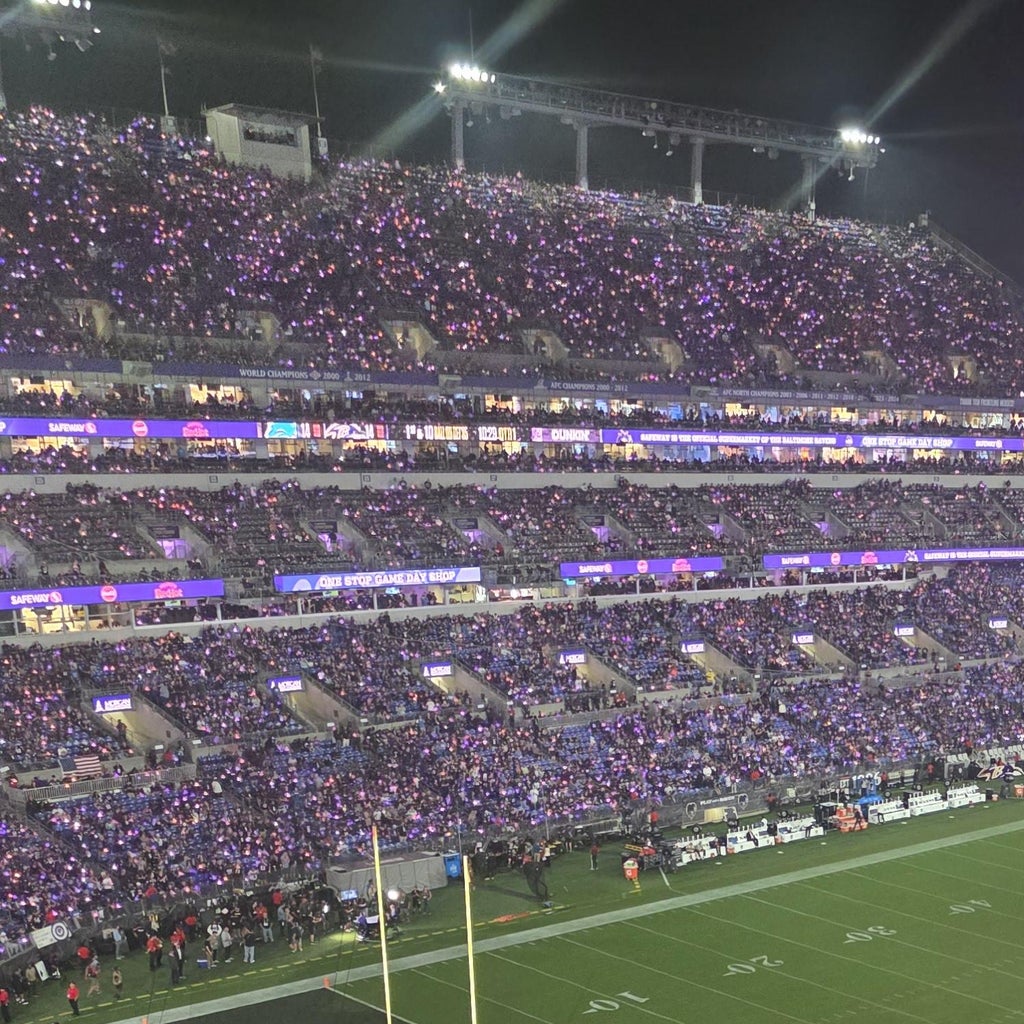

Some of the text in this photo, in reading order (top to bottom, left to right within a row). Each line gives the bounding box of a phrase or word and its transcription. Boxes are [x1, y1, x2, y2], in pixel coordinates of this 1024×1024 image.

[239, 368, 266, 377] WORLD
[267, 369, 309, 379] CHAMPIONS
[354, 373, 371, 381] 2012
[563, 382, 596, 391] CHAMPIONS
[49, 422, 85, 433] SAFEWAY
[551, 428, 591, 439] DUNKIN'
[862, 437, 953, 448] ONE STOP GAME DAY SHOP
[319, 570, 456, 588] ONE STOP GAME DAY SHOP
[11, 593, 50, 605] SAFEWAY
[852, 925, 897, 943] 30
[741, 954, 784, 976] 20
[603, 989, 650, 1013] 10
